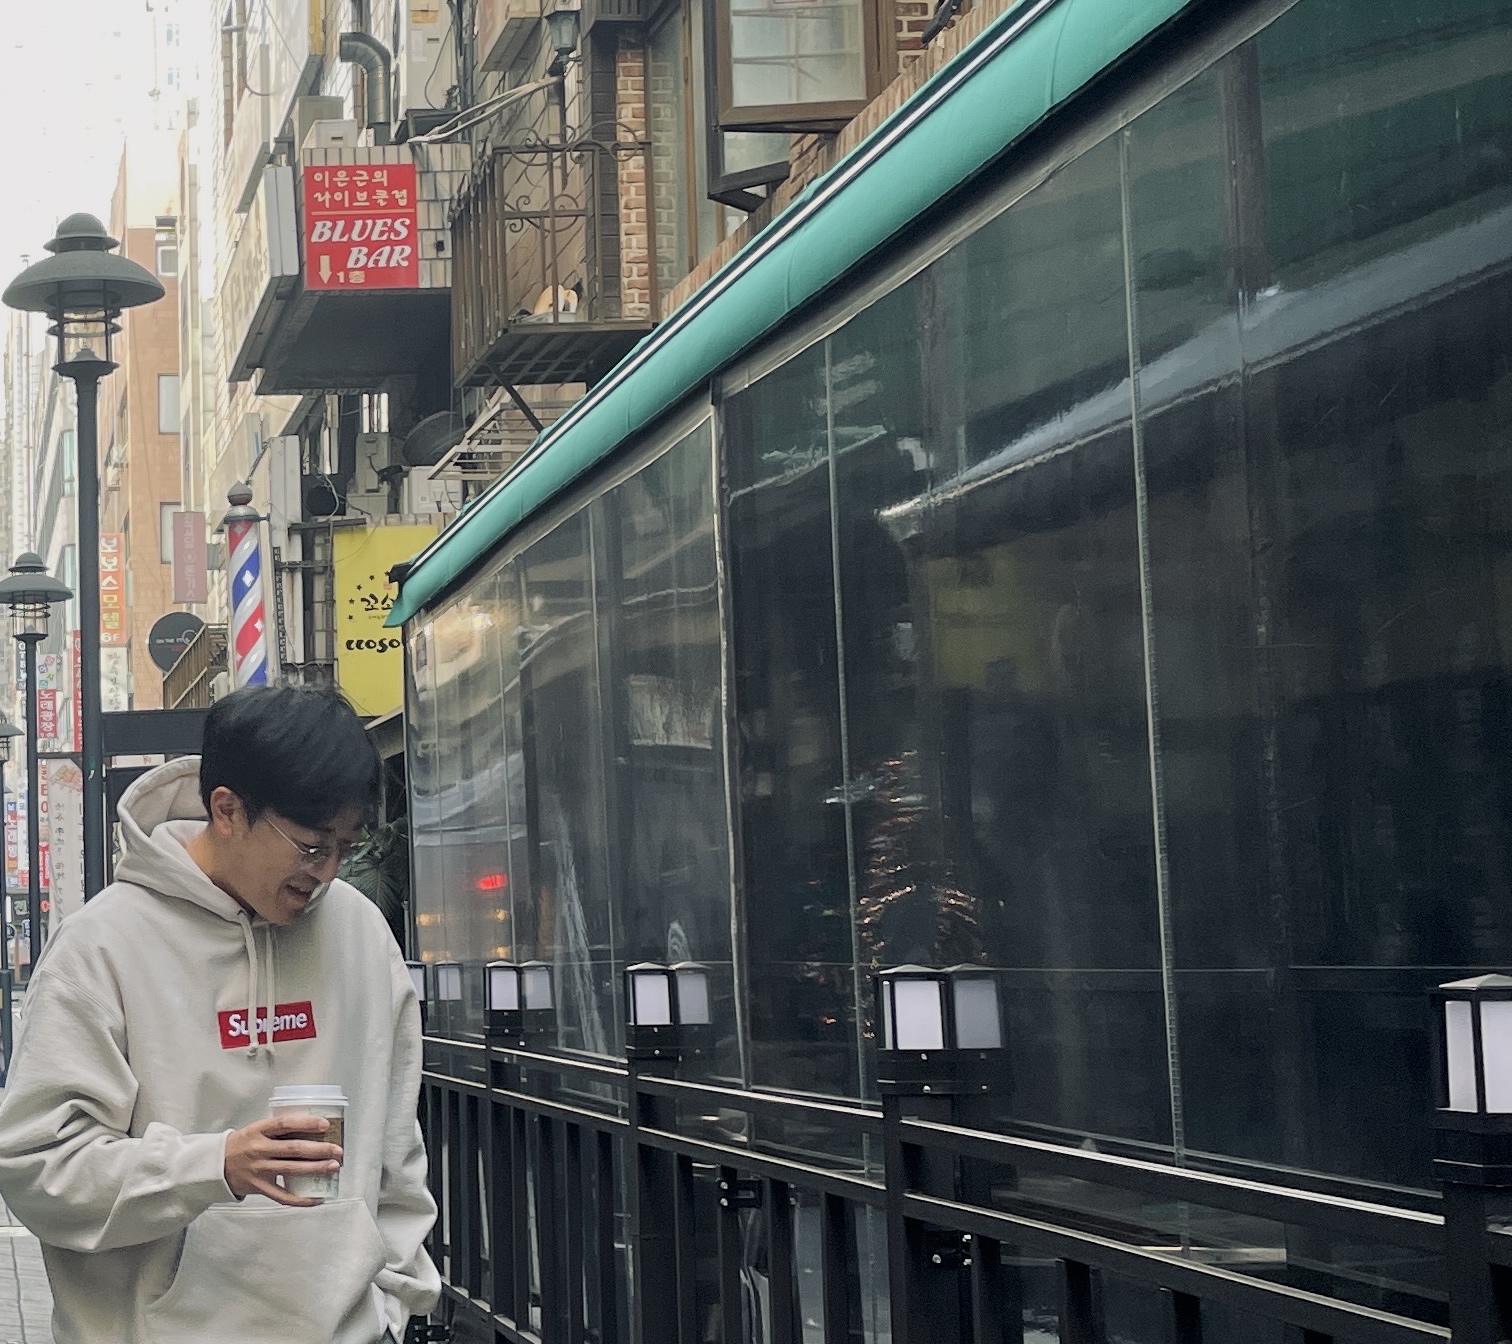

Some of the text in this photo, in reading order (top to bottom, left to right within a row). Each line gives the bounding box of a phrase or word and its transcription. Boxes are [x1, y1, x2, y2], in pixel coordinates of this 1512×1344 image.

[313, 169, 388, 188] 이은근의
[313, 189, 408, 208] 라이브클럽
[310, 218, 411, 243] BLUES
[346, 245, 412, 269] BAR
[100, 631, 121, 643] 6F
